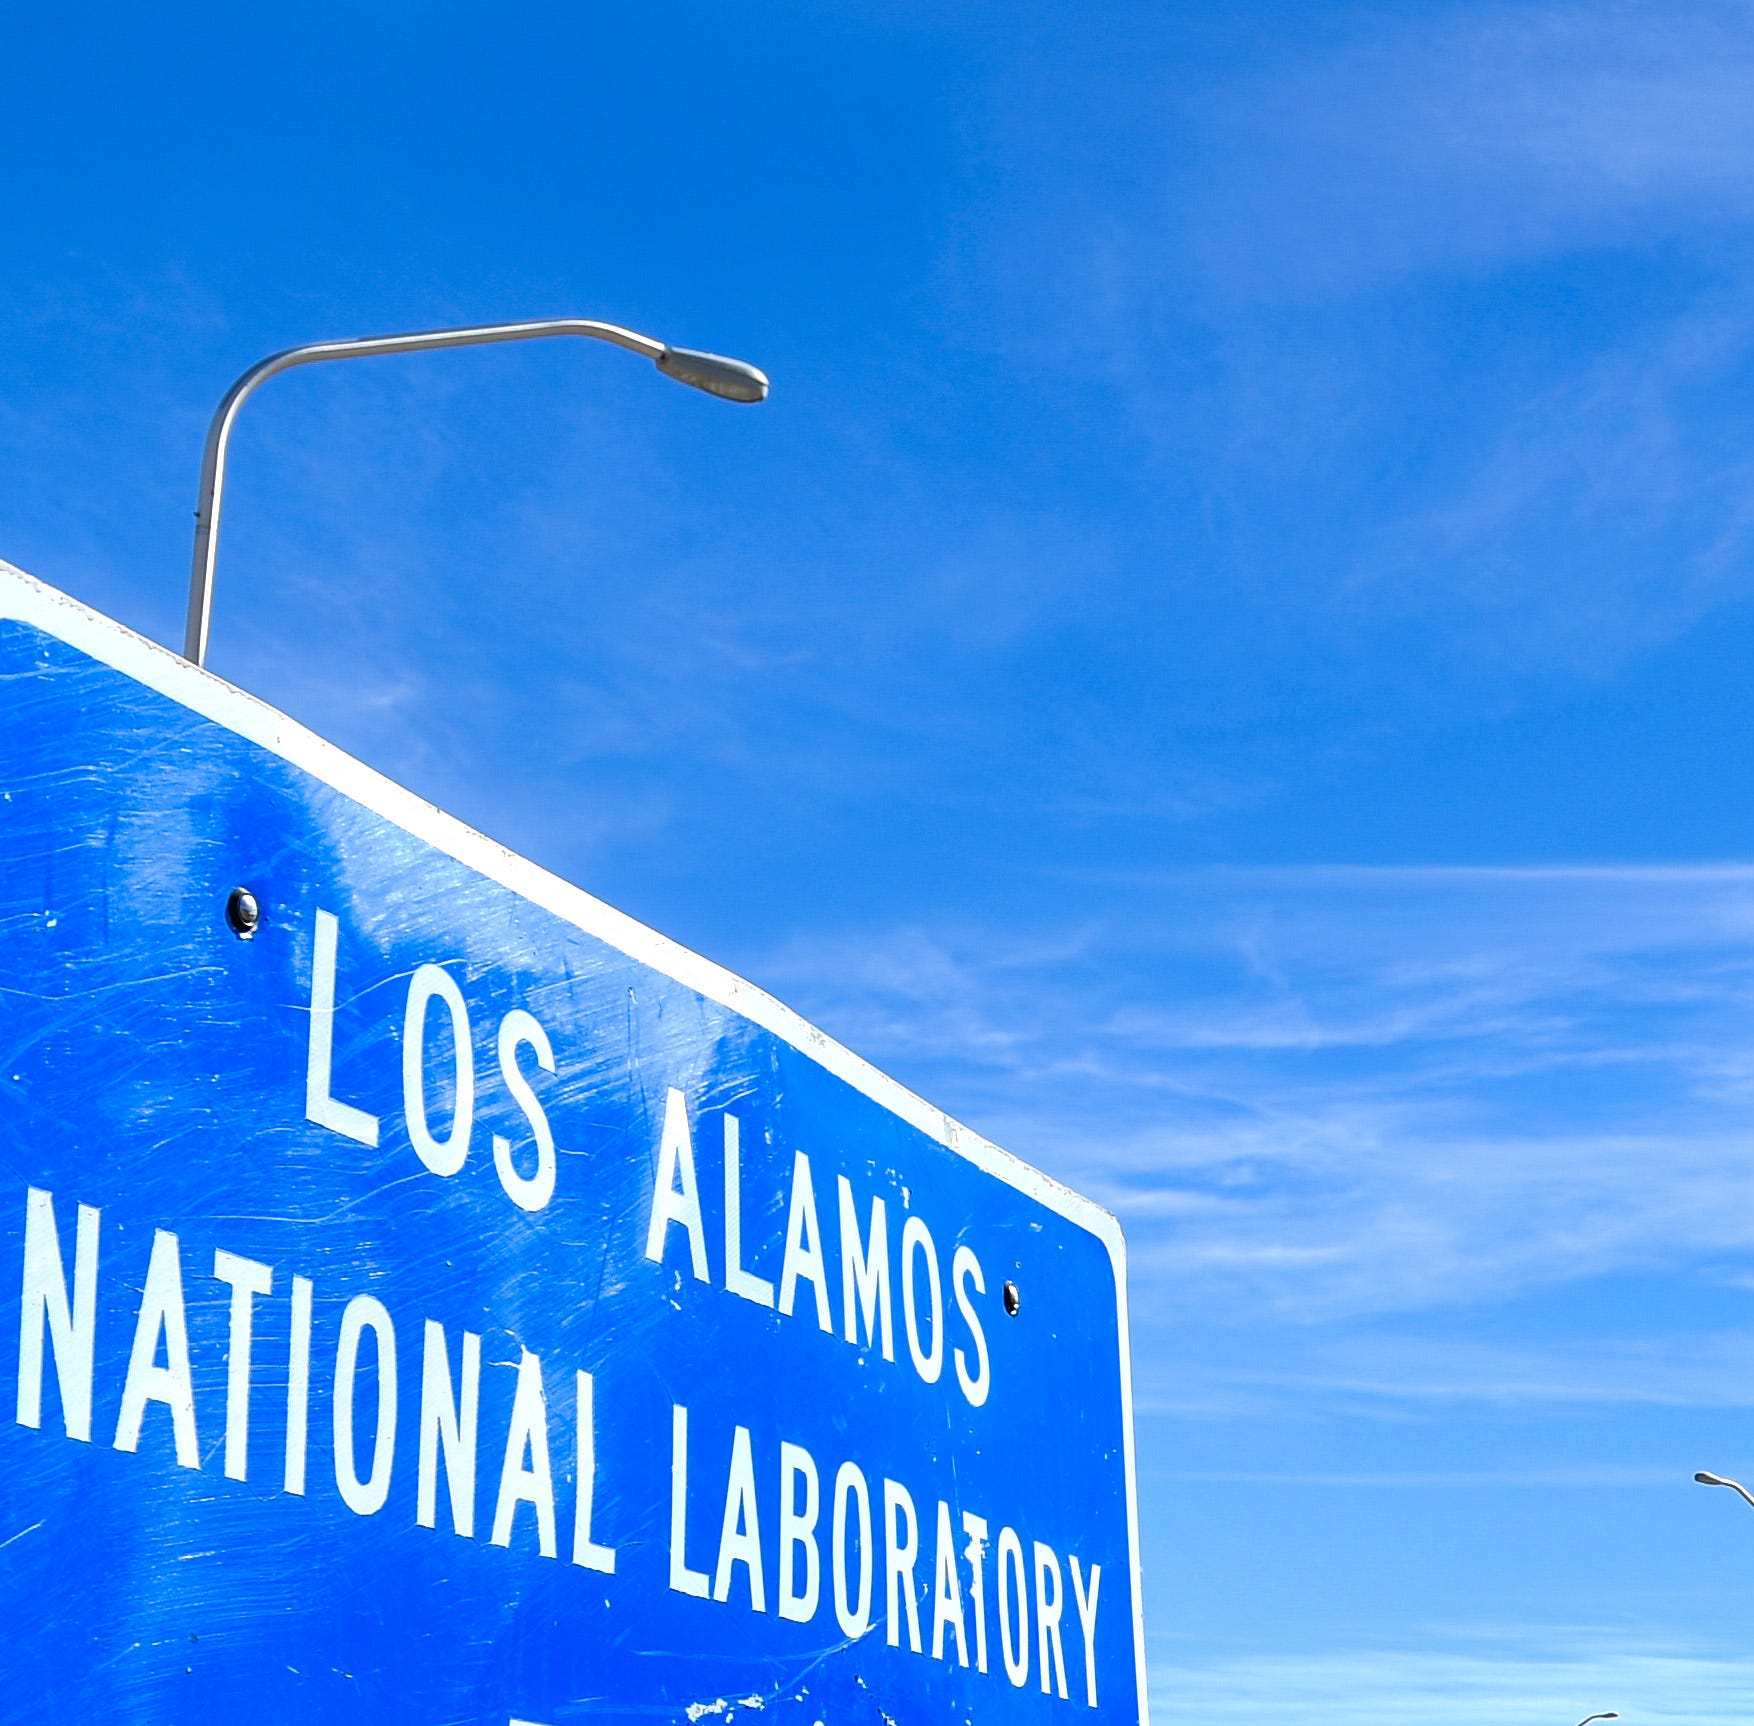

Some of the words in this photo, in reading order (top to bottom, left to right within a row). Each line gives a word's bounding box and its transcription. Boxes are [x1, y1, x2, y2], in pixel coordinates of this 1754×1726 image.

[305, 909, 557, 1212] LOS
[645, 1081, 991, 1408] ALAMOS
[16, 1187, 616, 1574] NATIONAL
[669, 1404, 1102, 1708] LABORATORY
